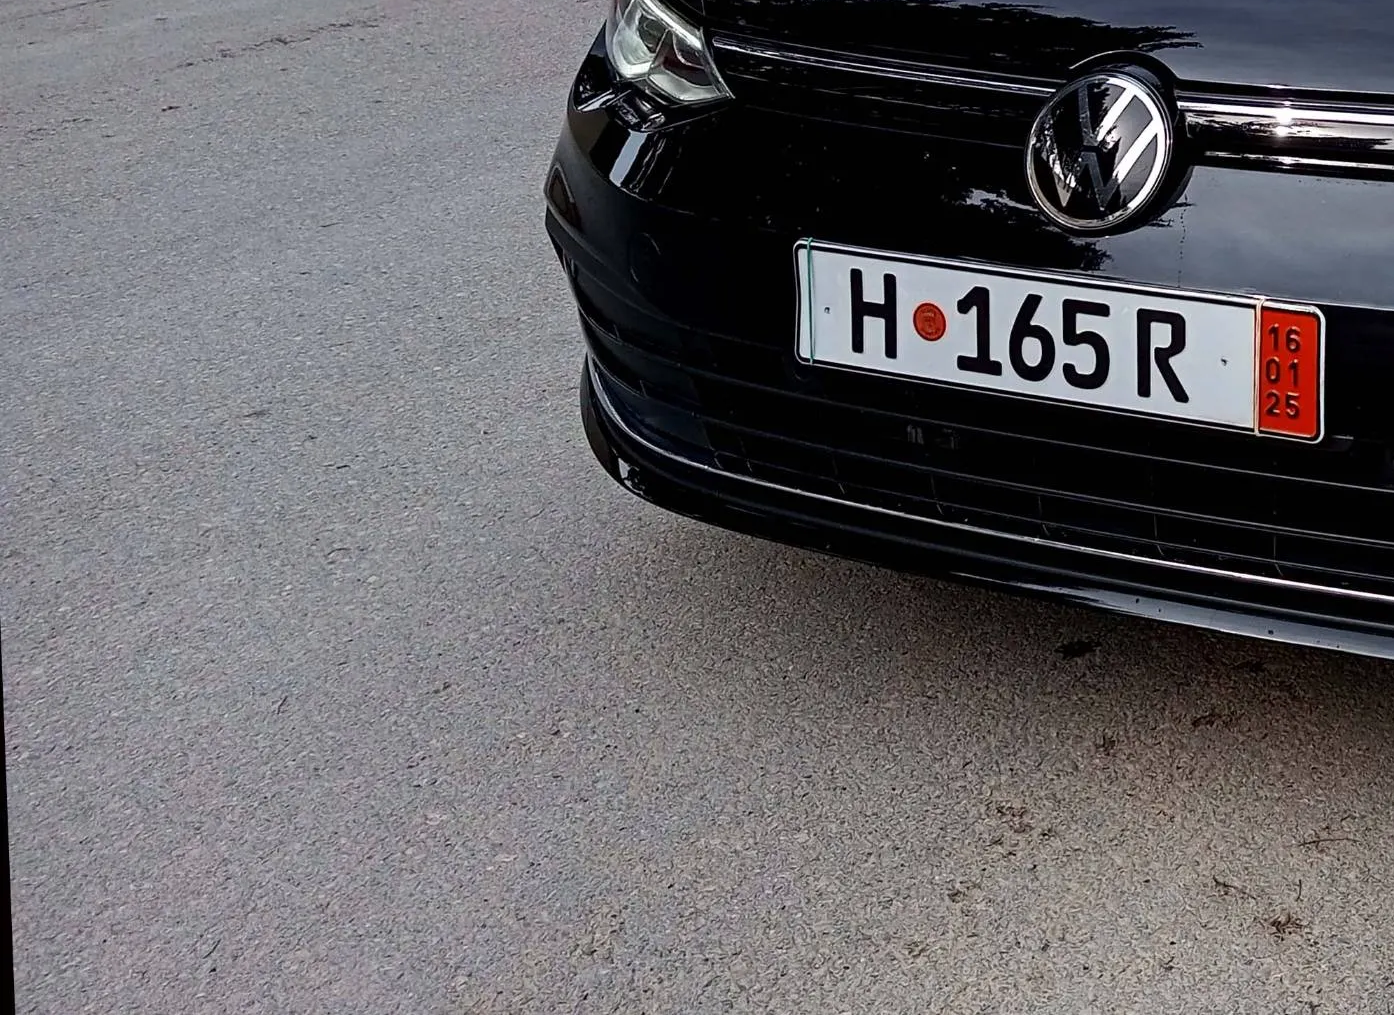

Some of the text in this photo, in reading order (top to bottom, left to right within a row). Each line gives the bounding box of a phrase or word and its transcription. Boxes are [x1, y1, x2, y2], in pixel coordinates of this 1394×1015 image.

[850, 268, 1190, 404] H 165 R
[1268, 323, 1301, 353] 16
[1265, 356, 1299, 387] 01
[1264, 389, 1300, 419] 25
